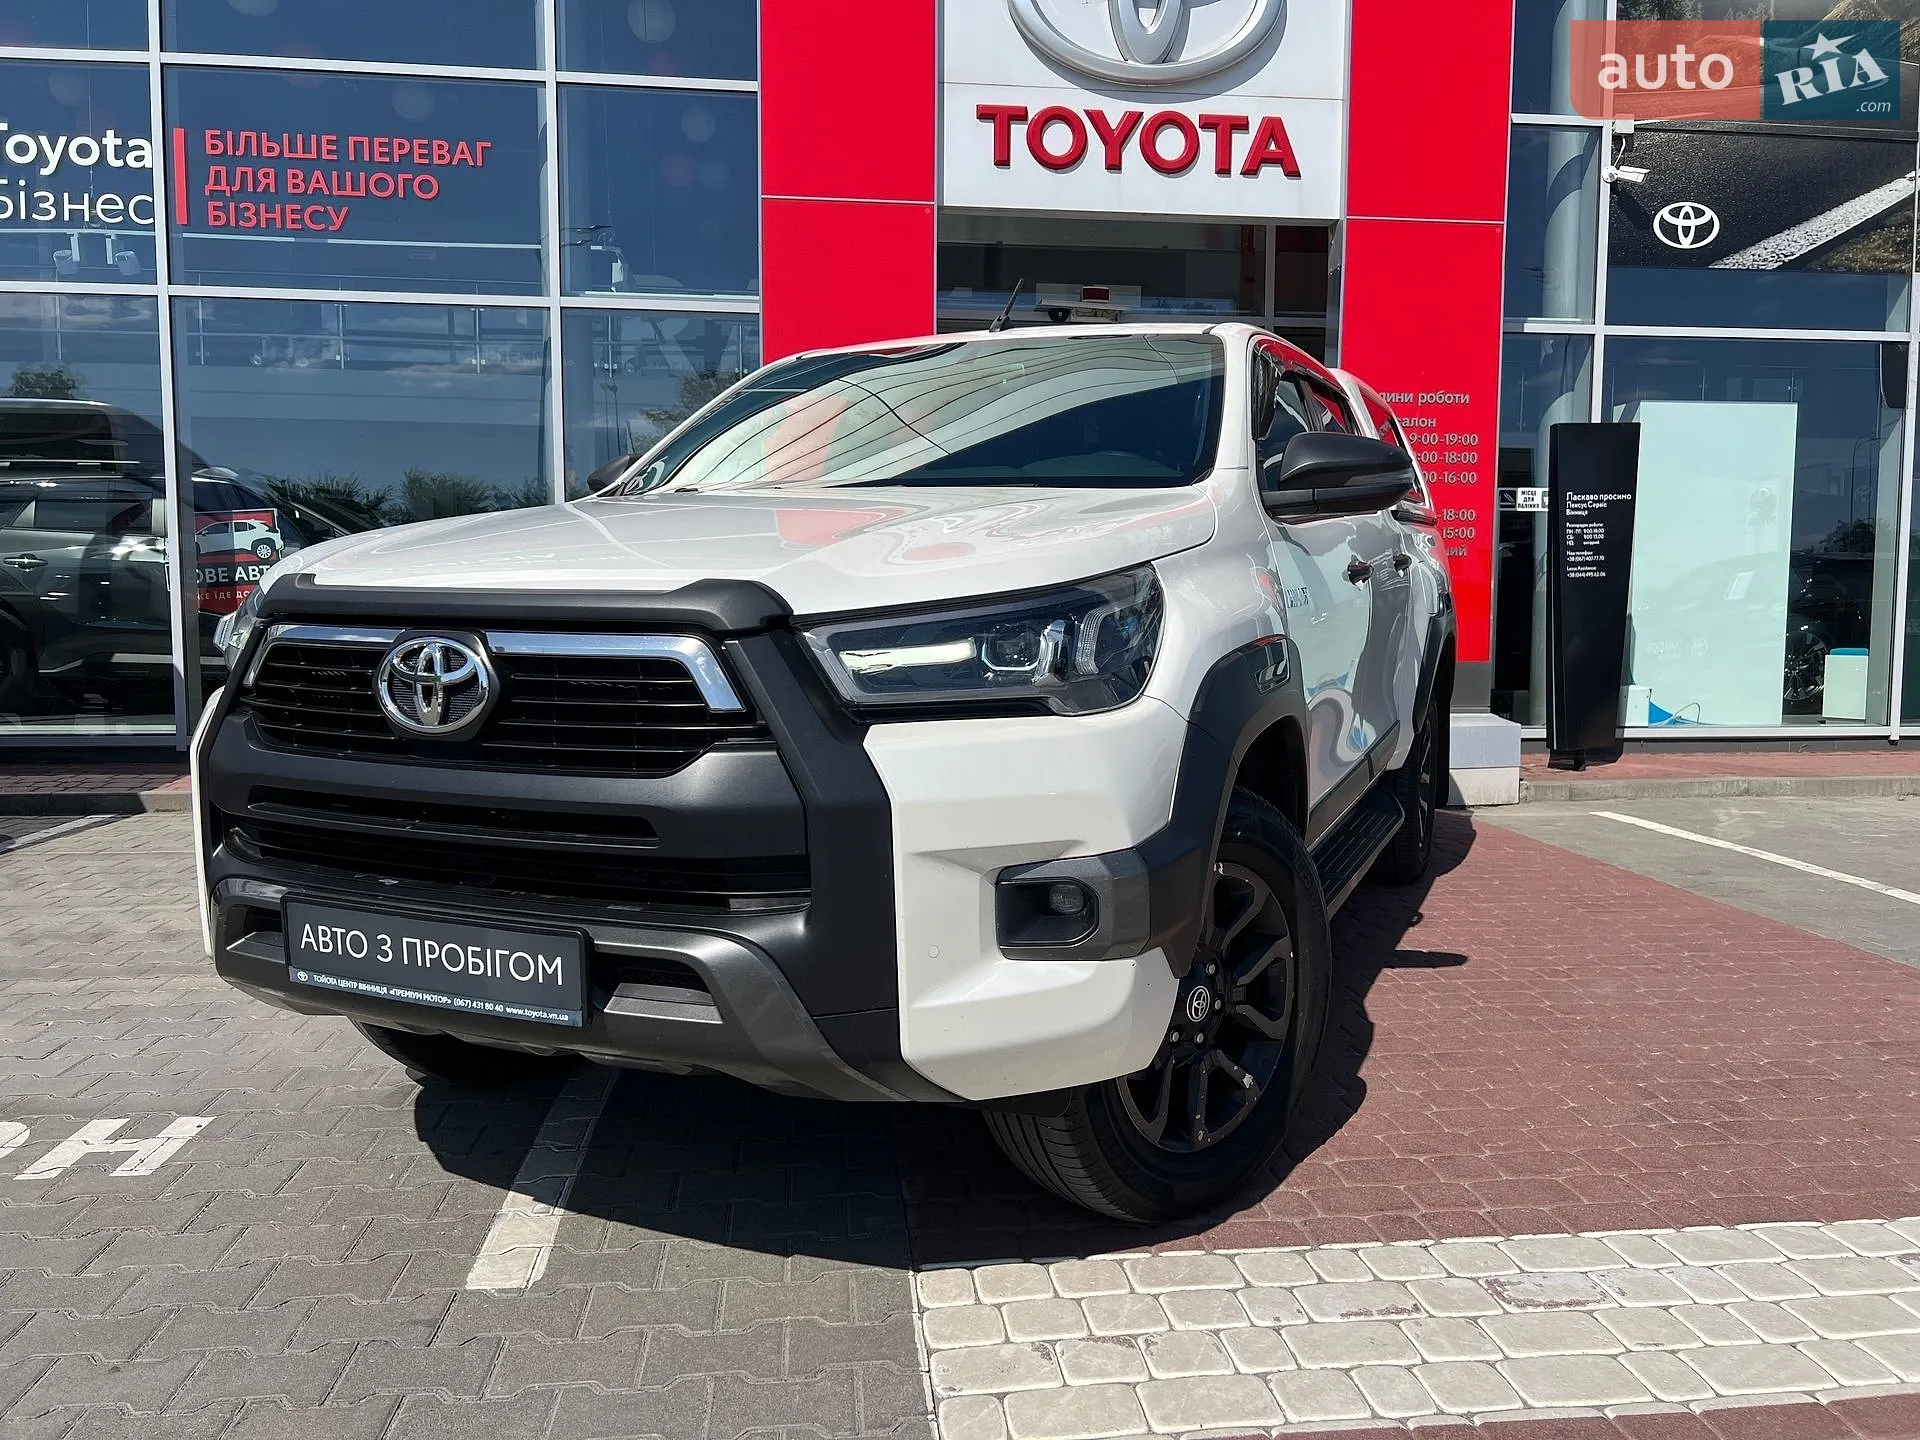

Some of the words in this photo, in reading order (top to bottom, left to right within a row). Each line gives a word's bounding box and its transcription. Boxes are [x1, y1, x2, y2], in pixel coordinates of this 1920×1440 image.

[0, 122, 152, 176] oyota
[205, 129, 338, 161] БІЛЬШЕ
[348, 135, 492, 167] ПЕРЕВАГ
[976, 104, 1301, 177] TOYOTA
[204, 165, 276, 197] ДЛЯ
[287, 168, 440, 200] ВАШОГО
[207, 201, 349, 231] БІЗНЕСУ
[1418, 389, 1470, 407] роботи
[1442, 526, 1476, 539] 15:00
[234, 565, 272, 582] АВТ
[300, 923, 368, 960] АВТО
[401, 936, 563, 986] ПРОБІГОМ
[313, 974, 338, 986] ТОЙОТА
[338, 979, 358, 989] ЦЕНТР
[358, 983, 387, 995] ВІННИЦЯ
[453, 997, 472, 1008] (067)
[472, 1000, 485, 1010] 431
[485, 1002, 494, 1011] 80
[495, 1004, 504, 1012] 40
